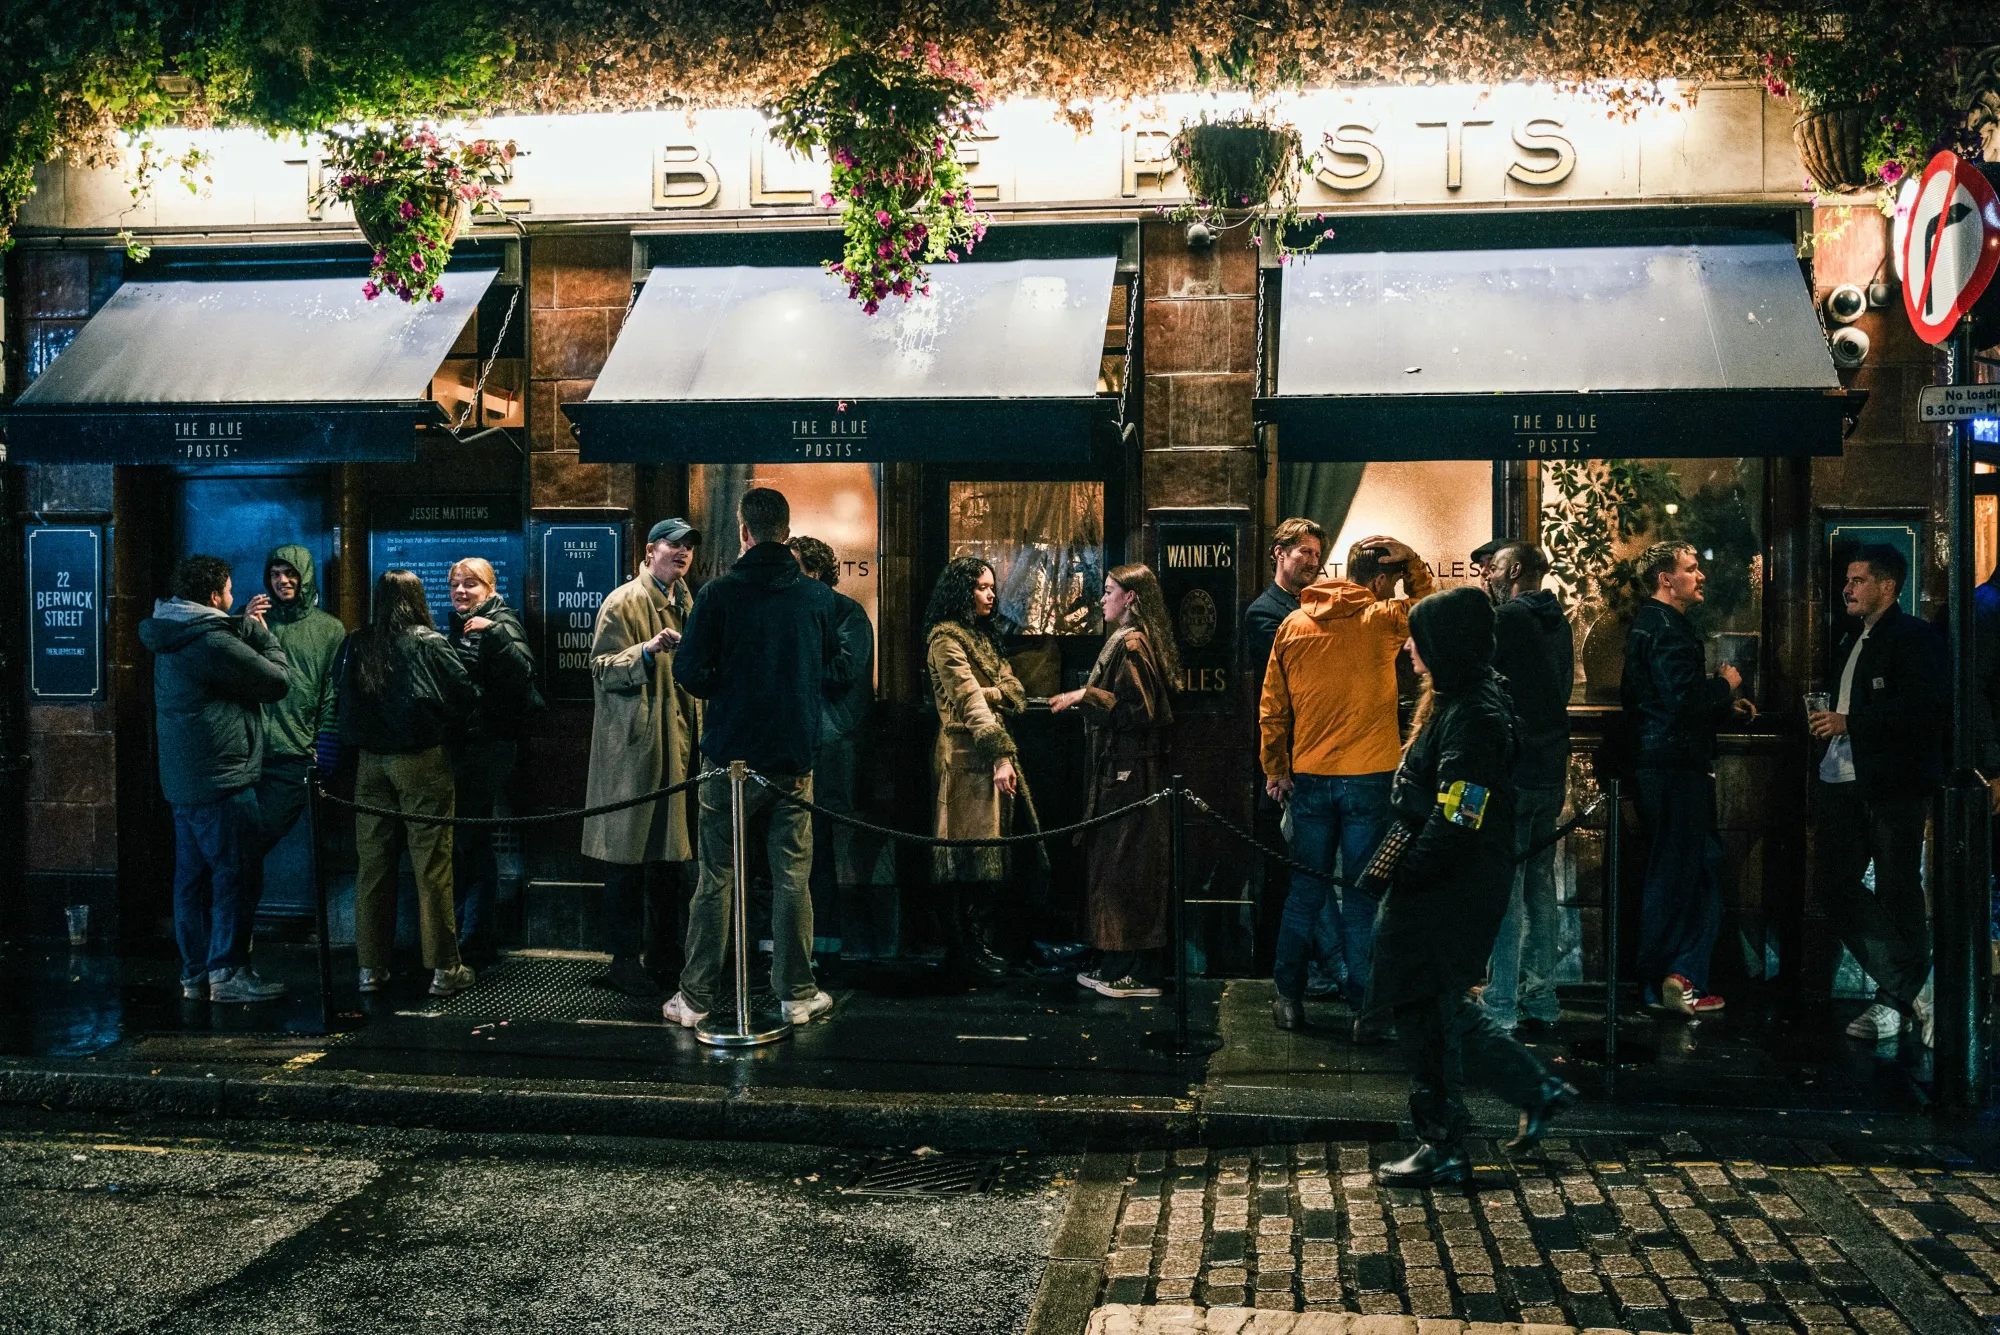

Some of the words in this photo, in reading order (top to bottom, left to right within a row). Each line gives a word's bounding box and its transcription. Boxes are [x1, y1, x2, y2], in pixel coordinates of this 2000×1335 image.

[284, 150, 532, 220] TE
[651, 130, 1001, 209] BLE
[1121, 118, 1578, 198] PSTS
[1945, 390, 1963, 401] No
[1967, 388, 2000, 400] loadi
[1926, 404, 1955, 416] 8.30
[1958, 406, 1976, 415] am
[175, 422, 198, 436] THE
[209, 422, 243, 436] BLUE
[792, 421, 817, 434] THE
[831, 420, 867, 434] BLUE
[1513, 415, 1541, 429] THE
[1557, 414, 1597, 429] BLUE
[187, 444, 229, 458] POSTS
[805, 444, 852, 457] POSTS
[1528, 439, 1580, 453] POSTS
[410, 507, 439, 520] JESSIE
[443, 507, 489, 520] MATTHEWS
[564, 541, 576, 549] THE
[581, 541, 597, 549] BLUE
[569, 551, 591, 559] POSTS
[1167, 541, 1231, 568] WATNEY'S
[57, 571, 70, 588] 22
[577, 571, 585, 588] A
[36, 591, 93, 610] BERWICK
[558, 592, 603, 608] PROPER
[44, 610, 84, 627] STREET
[569, 612, 592, 629] OLD
[557, 632, 595, 649] LONDO
[1187, 668, 1226, 692] LES
